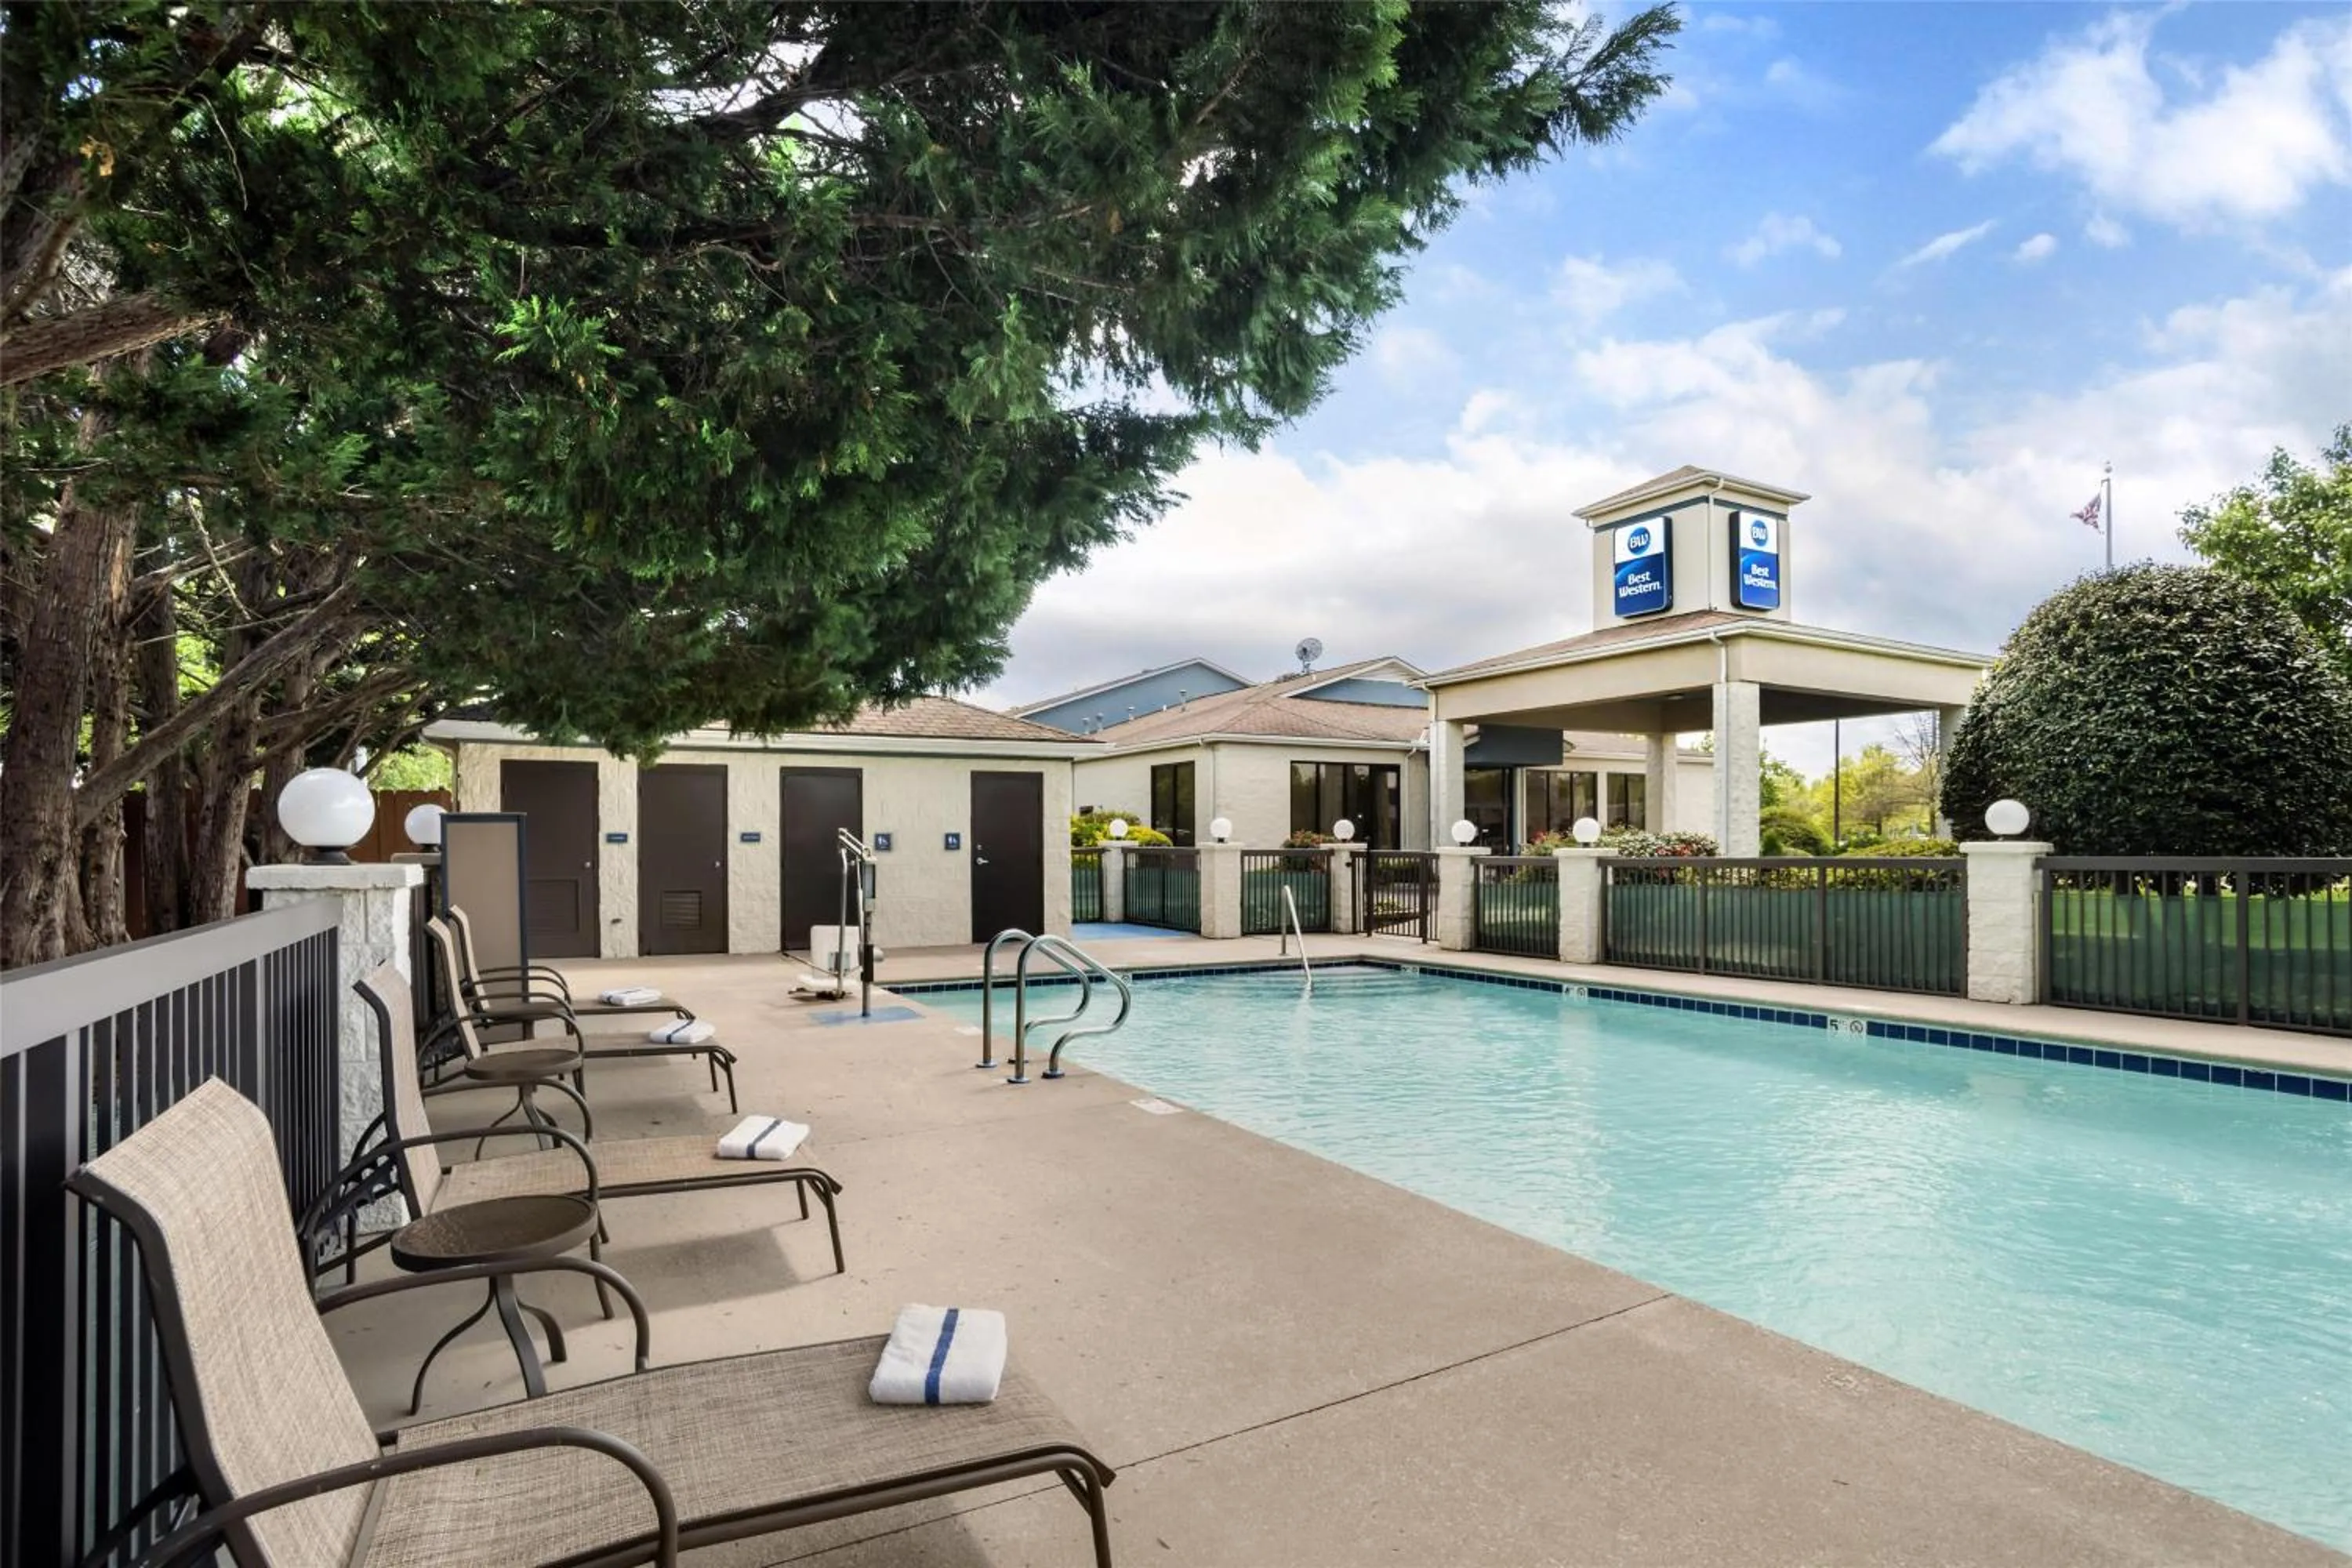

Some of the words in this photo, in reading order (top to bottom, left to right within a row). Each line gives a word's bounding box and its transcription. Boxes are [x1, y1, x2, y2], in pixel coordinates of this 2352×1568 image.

[1752, 526, 1766, 540] BW
[1630, 534, 1649, 549] BW
[1751, 564, 1769, 577] Best
[1628, 572, 1651, 585] Best
[1743, 574, 1776, 590] Western
[1618, 581, 1661, 598] Western
